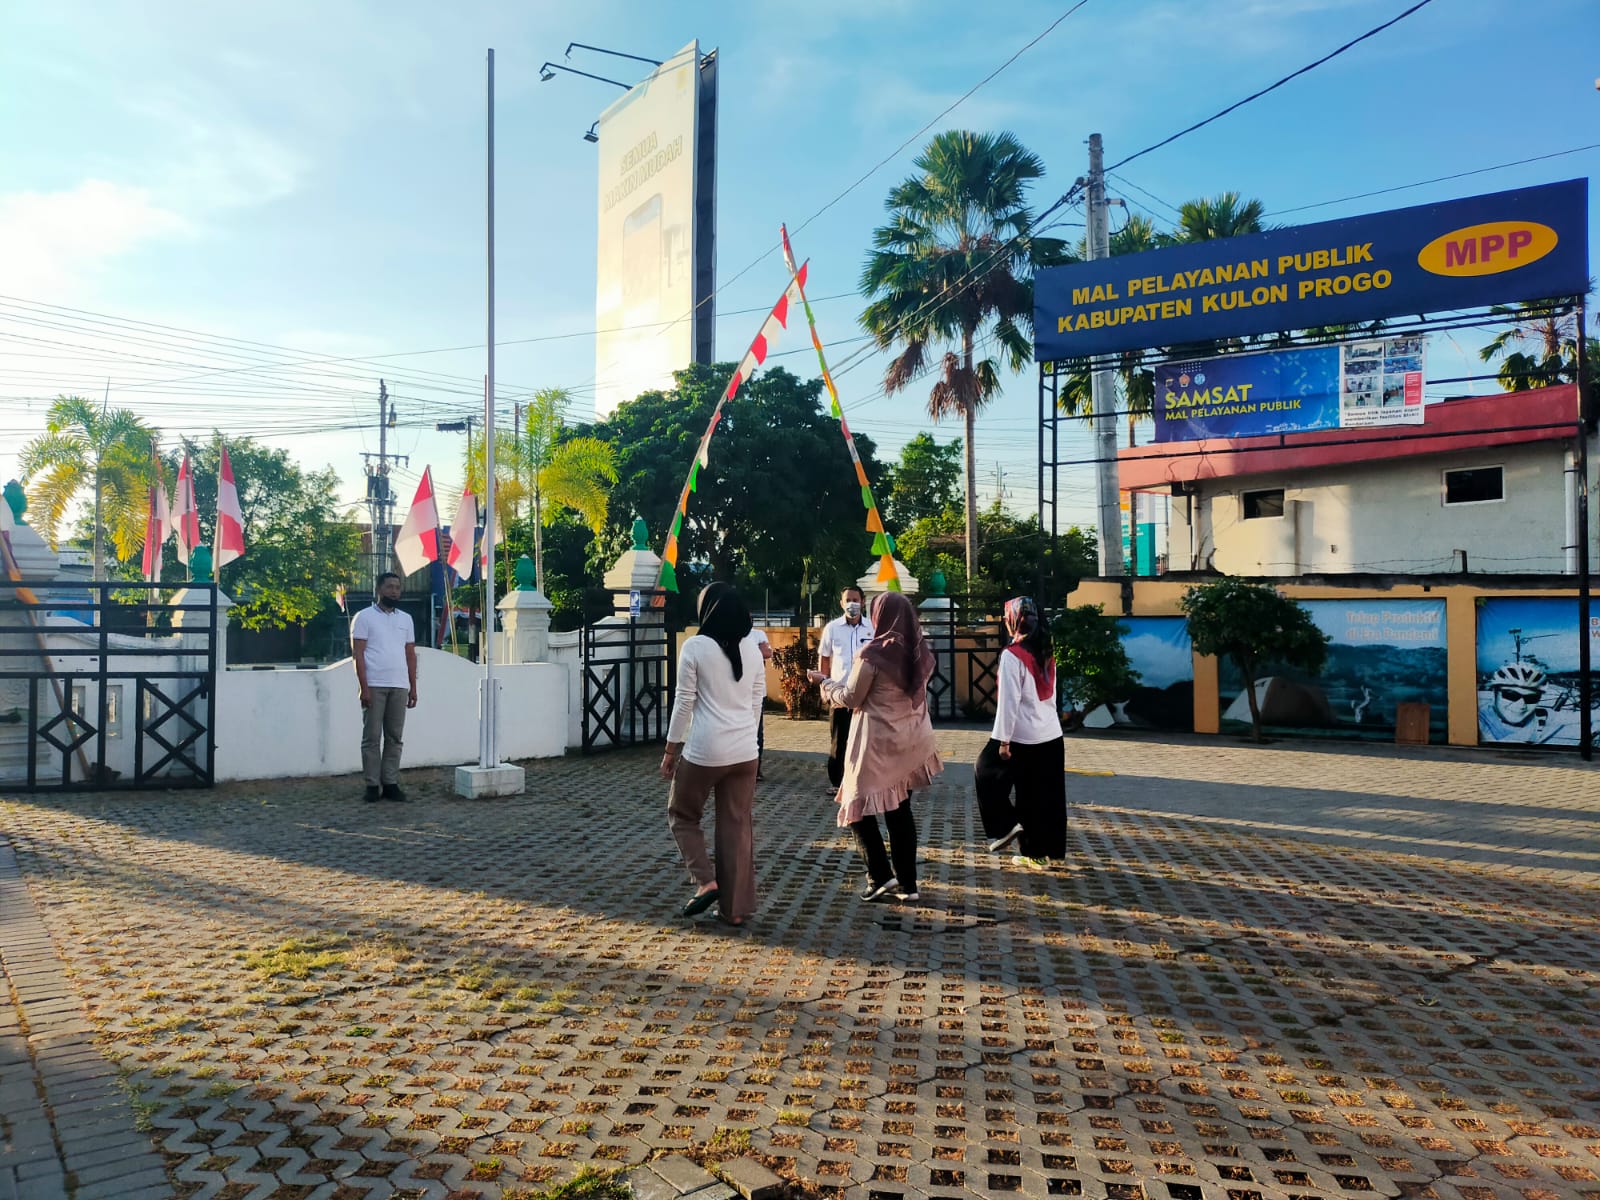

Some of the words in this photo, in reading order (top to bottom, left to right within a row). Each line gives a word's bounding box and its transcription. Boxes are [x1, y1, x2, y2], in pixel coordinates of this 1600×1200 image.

[620, 130, 658, 176] SEMUA
[639, 134, 683, 186] MUDAH
[1445, 229, 1533, 268] MPP
[1072, 283, 1119, 305] MAL
[1127, 259, 1268, 297] PELAYANAN
[1278, 242, 1374, 275] PUBLIK
[1057, 297, 1192, 334] KABUPATEN
[1202, 283, 1288, 314] KULON
[1298, 269, 1393, 300] PROGO
[1165, 383, 1253, 410] SAMSAT
[1165, 409, 1188, 421] MAL
[1191, 404, 1257, 418] PELAYANAN
[1260, 399, 1302, 413] PUBLIK
